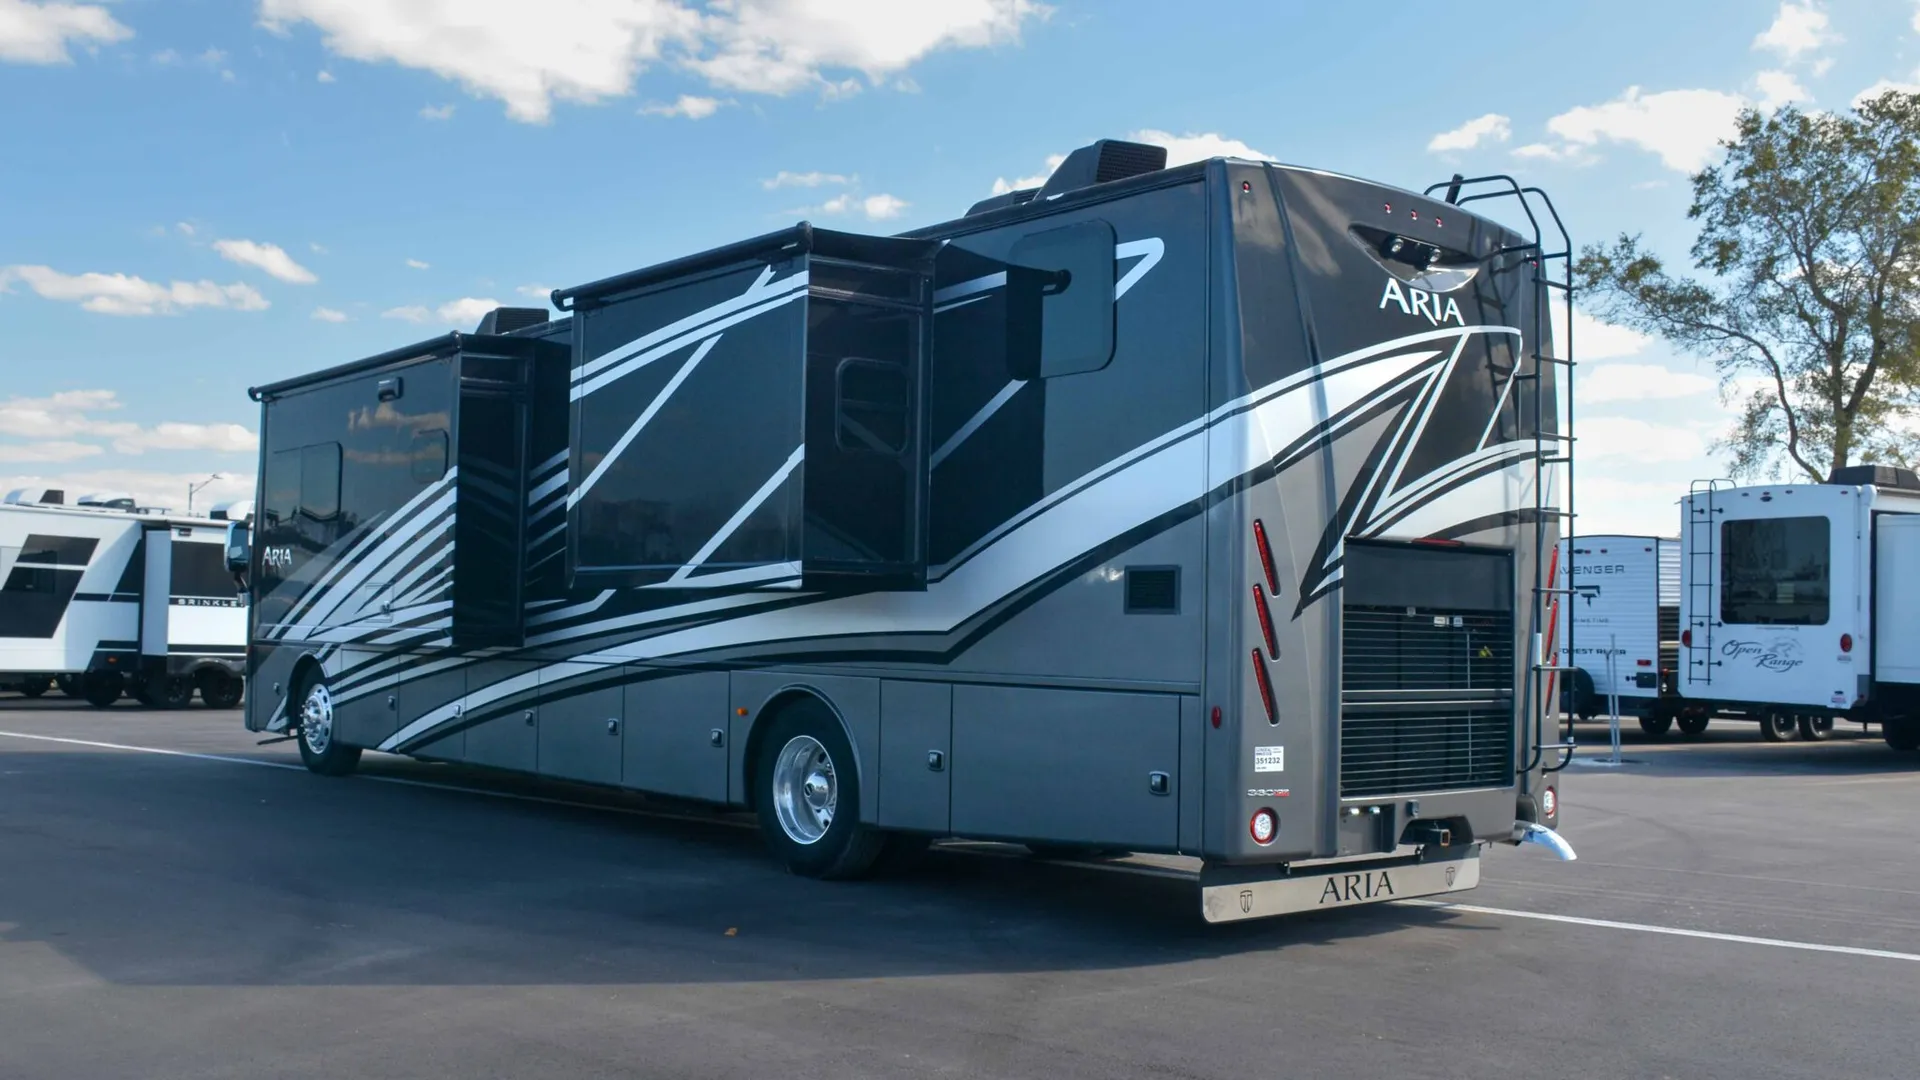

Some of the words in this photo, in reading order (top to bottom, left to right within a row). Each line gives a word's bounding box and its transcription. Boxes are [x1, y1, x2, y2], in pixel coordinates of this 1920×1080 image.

[1379, 277, 1465, 327] ARIA
[261, 545, 292, 569] ARIA
[1721, 639, 1765, 660] Open
[1753, 653, 1804, 673] Range
[1255, 756, 1281, 765] 351232
[1319, 871, 1395, 904] ARIA
